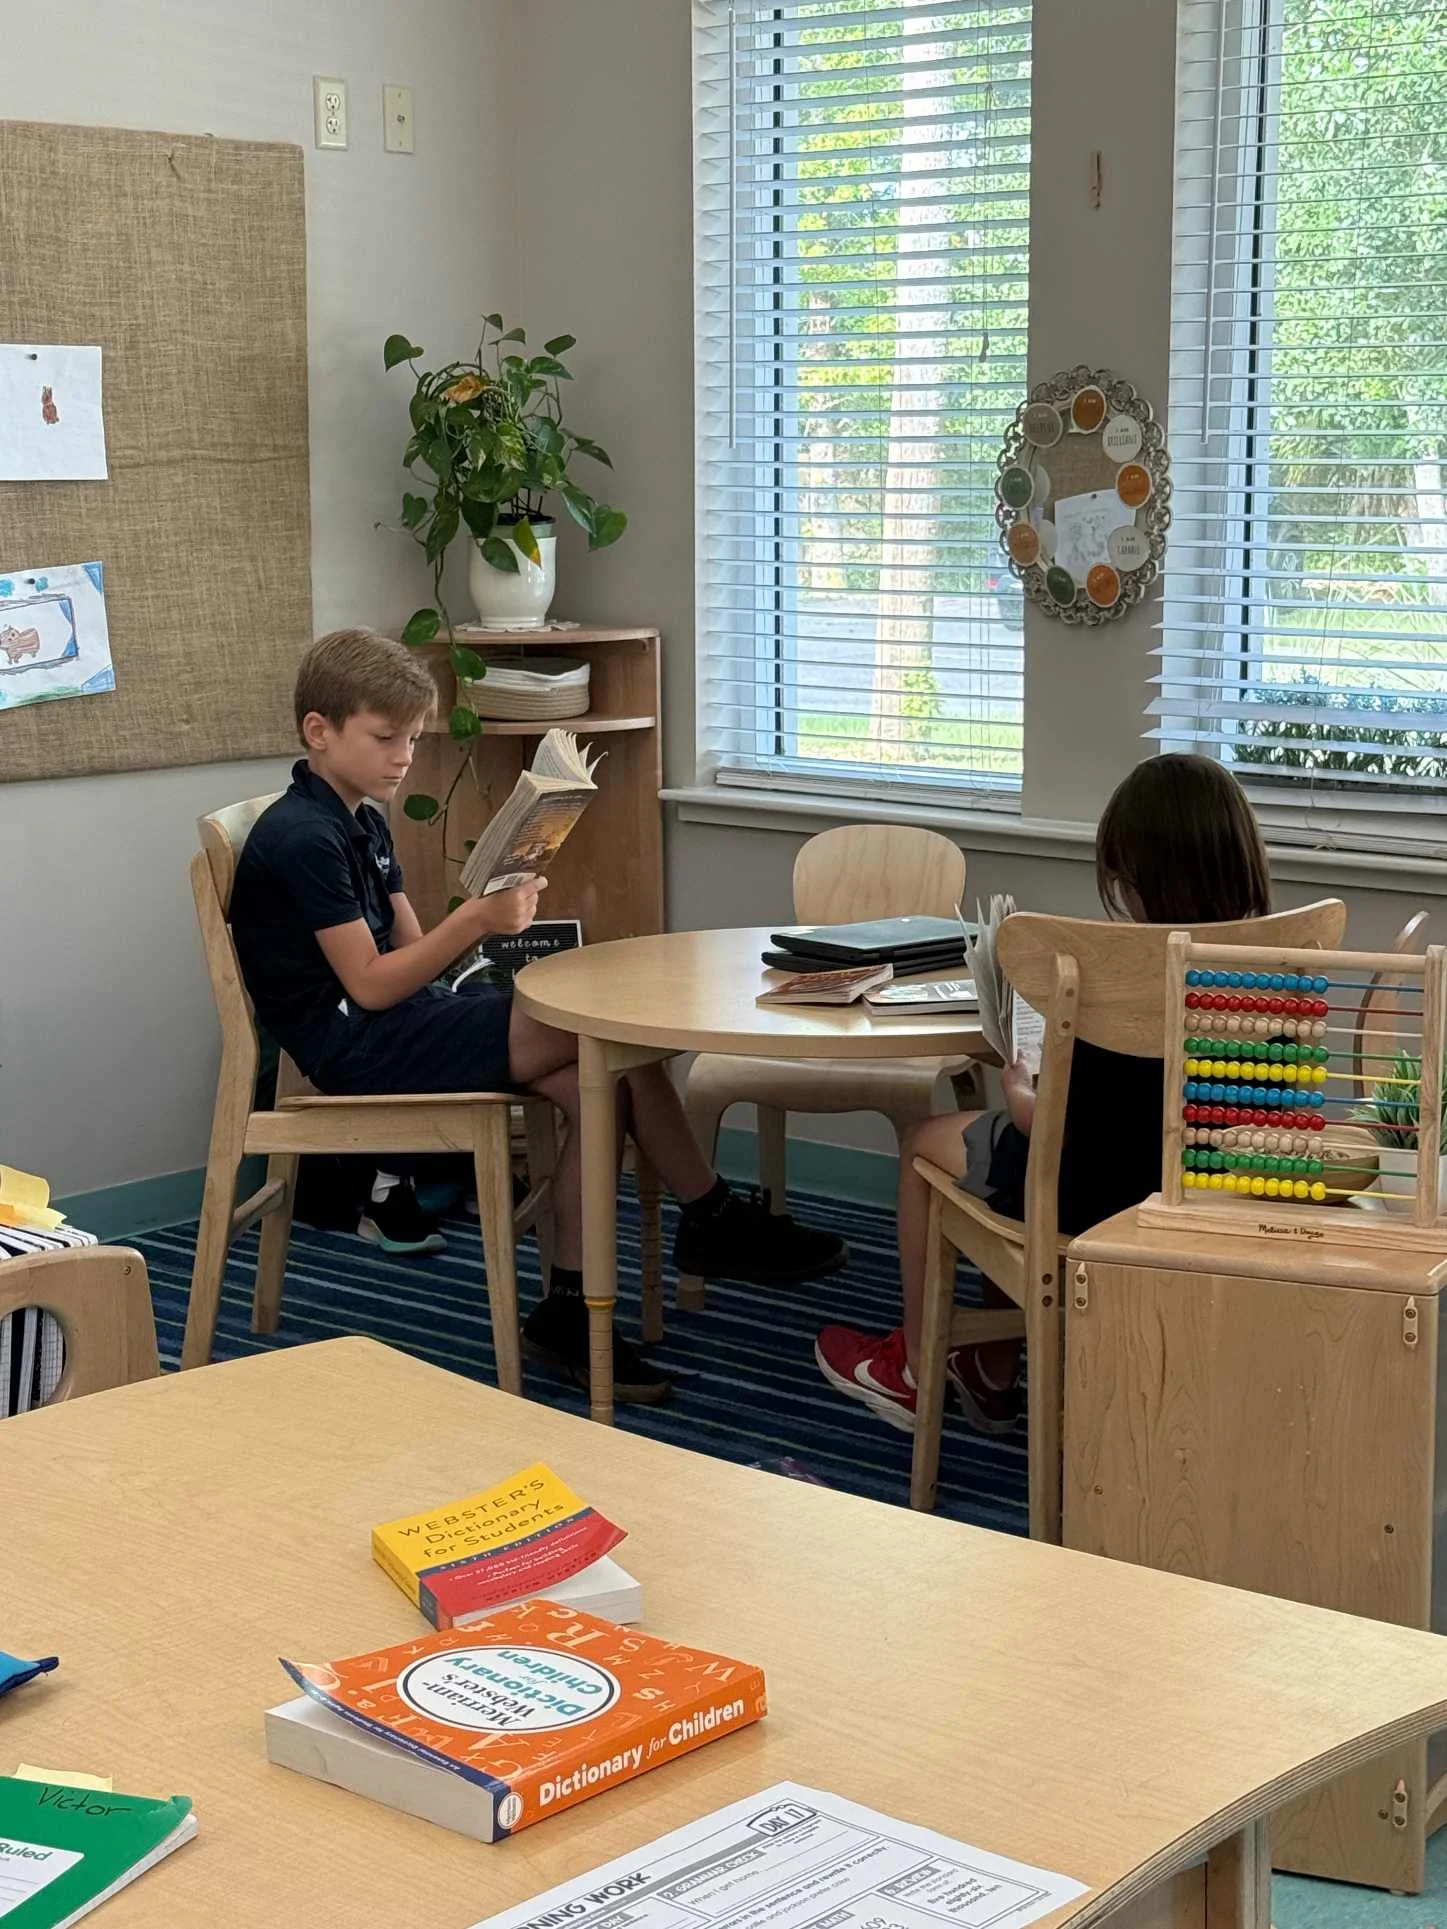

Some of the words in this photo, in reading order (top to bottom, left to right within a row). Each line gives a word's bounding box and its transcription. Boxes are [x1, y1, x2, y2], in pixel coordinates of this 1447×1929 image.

[501, 939, 560, 949] welcome
[398, 1479, 546, 1537] WEBSTER'S
[423, 1544, 457, 1559] for
[463, 1503, 566, 1547] Students
[425, 1499, 543, 1544] Dictionary
[443, 1656, 588, 1717] Dictionary
[496, 1649, 603, 1696] Children
[421, 1680, 522, 1728] Merriam-
[441, 1673, 537, 1719] Webster's
[538, 1743, 643, 1807] Dictionary
[646, 1734, 669, 1762] for
[668, 1698, 745, 1746] Children
[38, 1786, 132, 1817] Victor
[758, 1815, 789, 1834] DAY
[786, 1807, 806, 1821] 17
[584, 1872, 652, 1905] WORK
